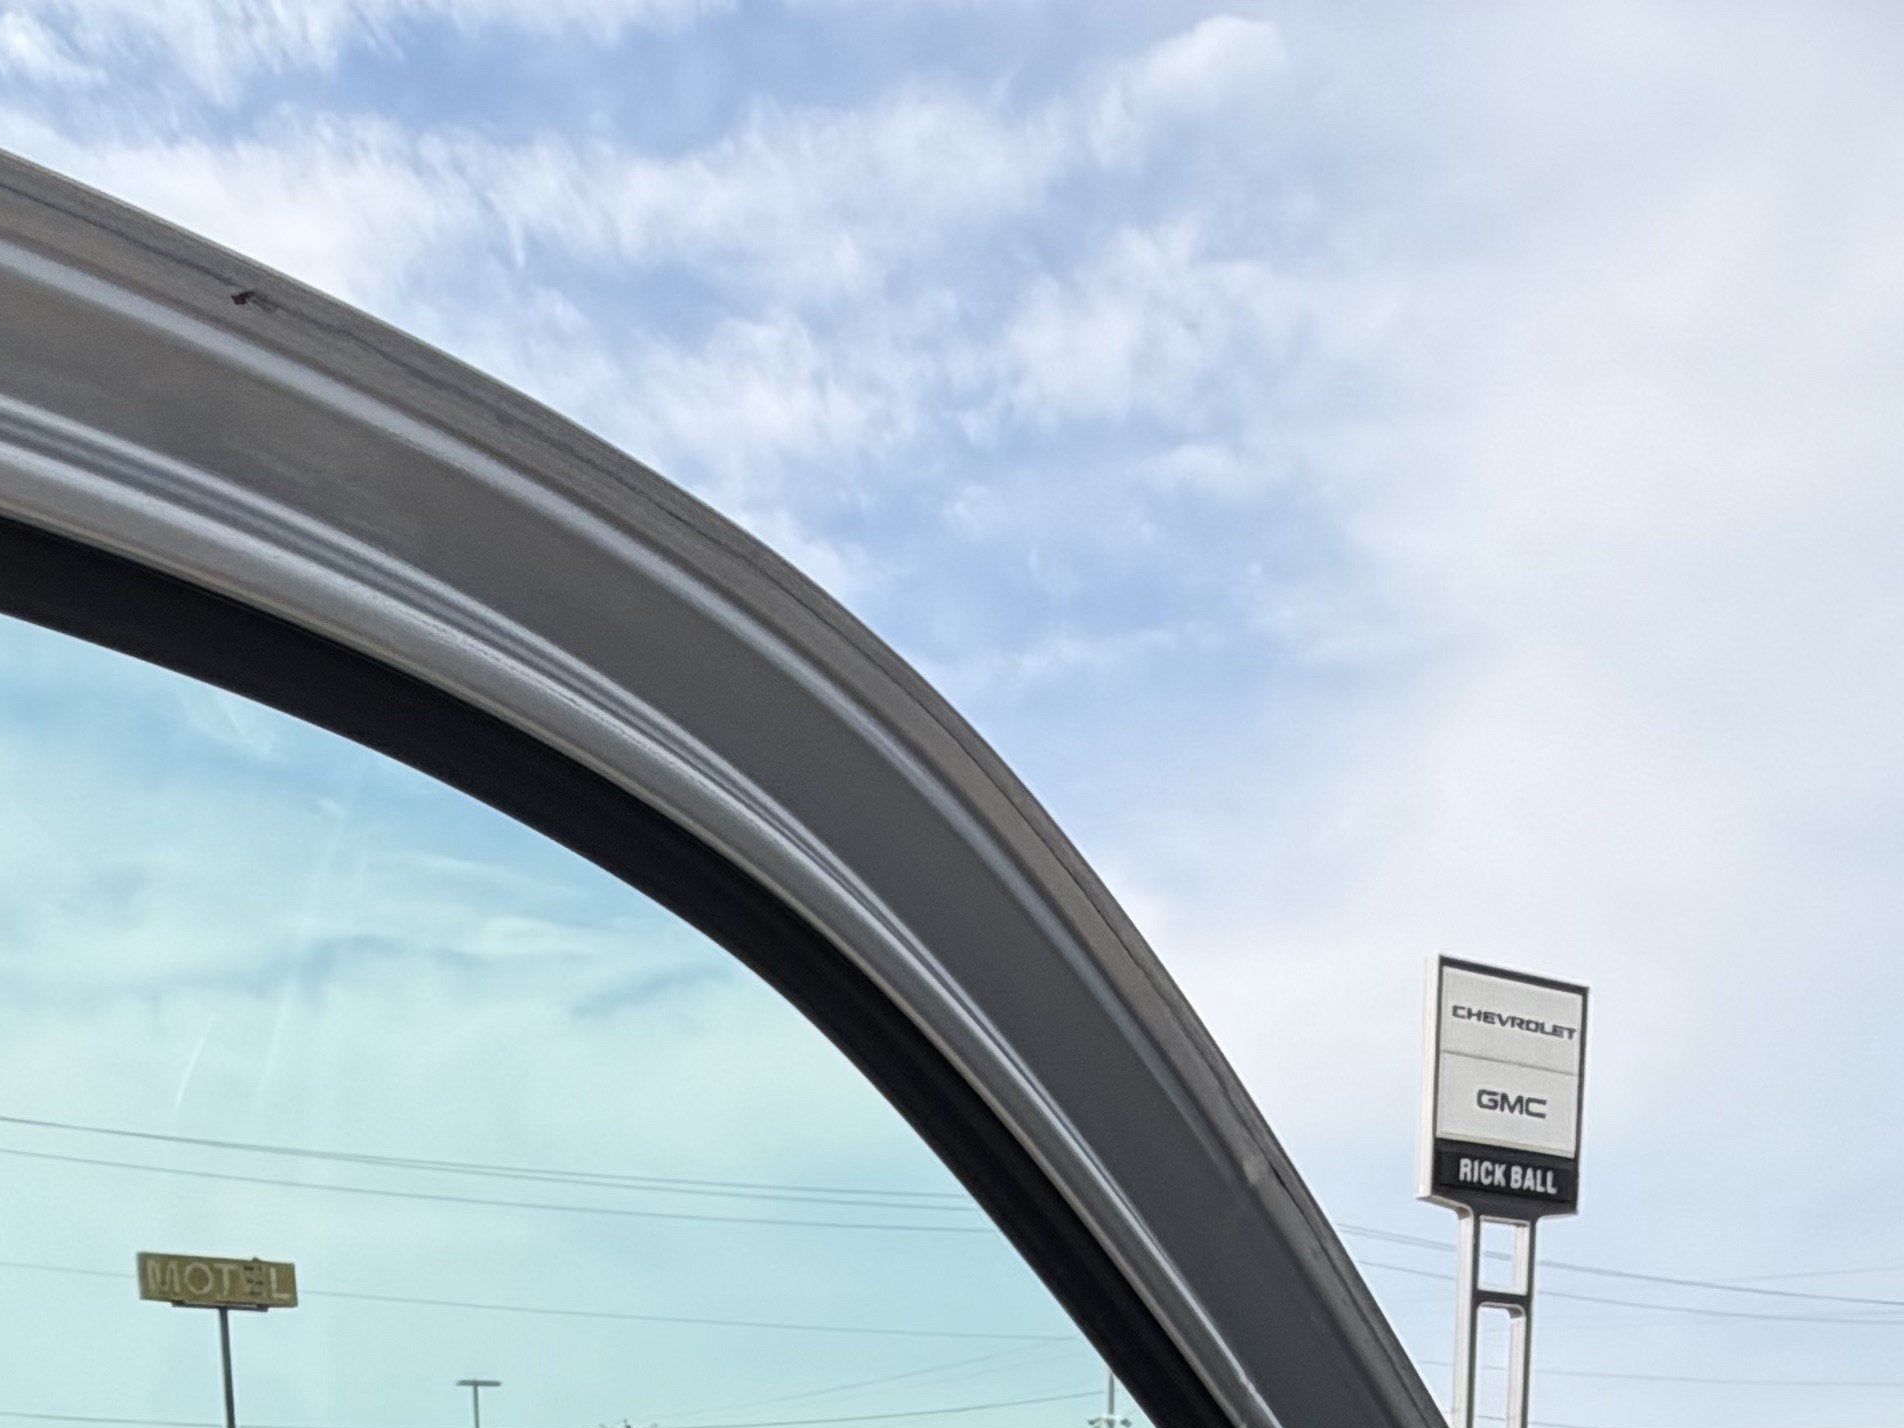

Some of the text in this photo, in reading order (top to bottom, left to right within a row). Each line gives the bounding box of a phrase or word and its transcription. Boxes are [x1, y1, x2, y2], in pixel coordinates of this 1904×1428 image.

[1452, 1005, 1578, 1040] CHEVROLET
[1476, 1088, 1548, 1119] GMC
[1458, 1157, 1559, 1195] RICK BALL
